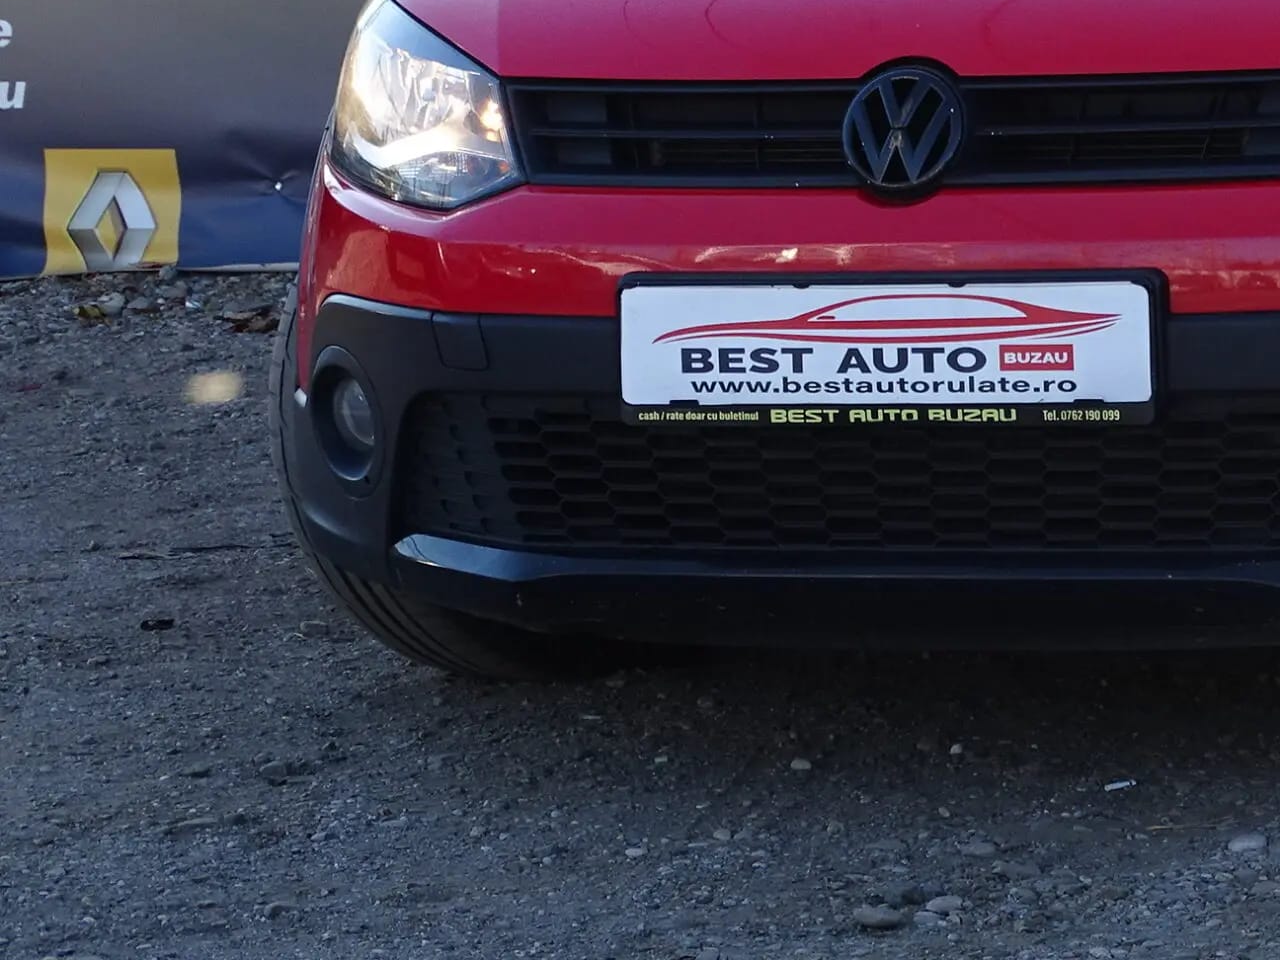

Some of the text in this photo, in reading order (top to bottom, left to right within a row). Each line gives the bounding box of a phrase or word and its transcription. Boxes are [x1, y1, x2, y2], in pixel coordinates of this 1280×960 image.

[681, 346, 1068, 374] BEST AUTO BUZAU
[691, 376, 1077, 394] www.bestautorulate.ro
[638, 411, 660, 421] cash
[666, 411, 684, 421] rate
[685, 411, 706, 421] doar
[707, 412, 718, 421] cu
[719, 411, 759, 421] buletinul
[770, 408, 1017, 423] BEST AUTO BUZAU
[1043, 409, 1120, 421] Tel. 0762 190 099
